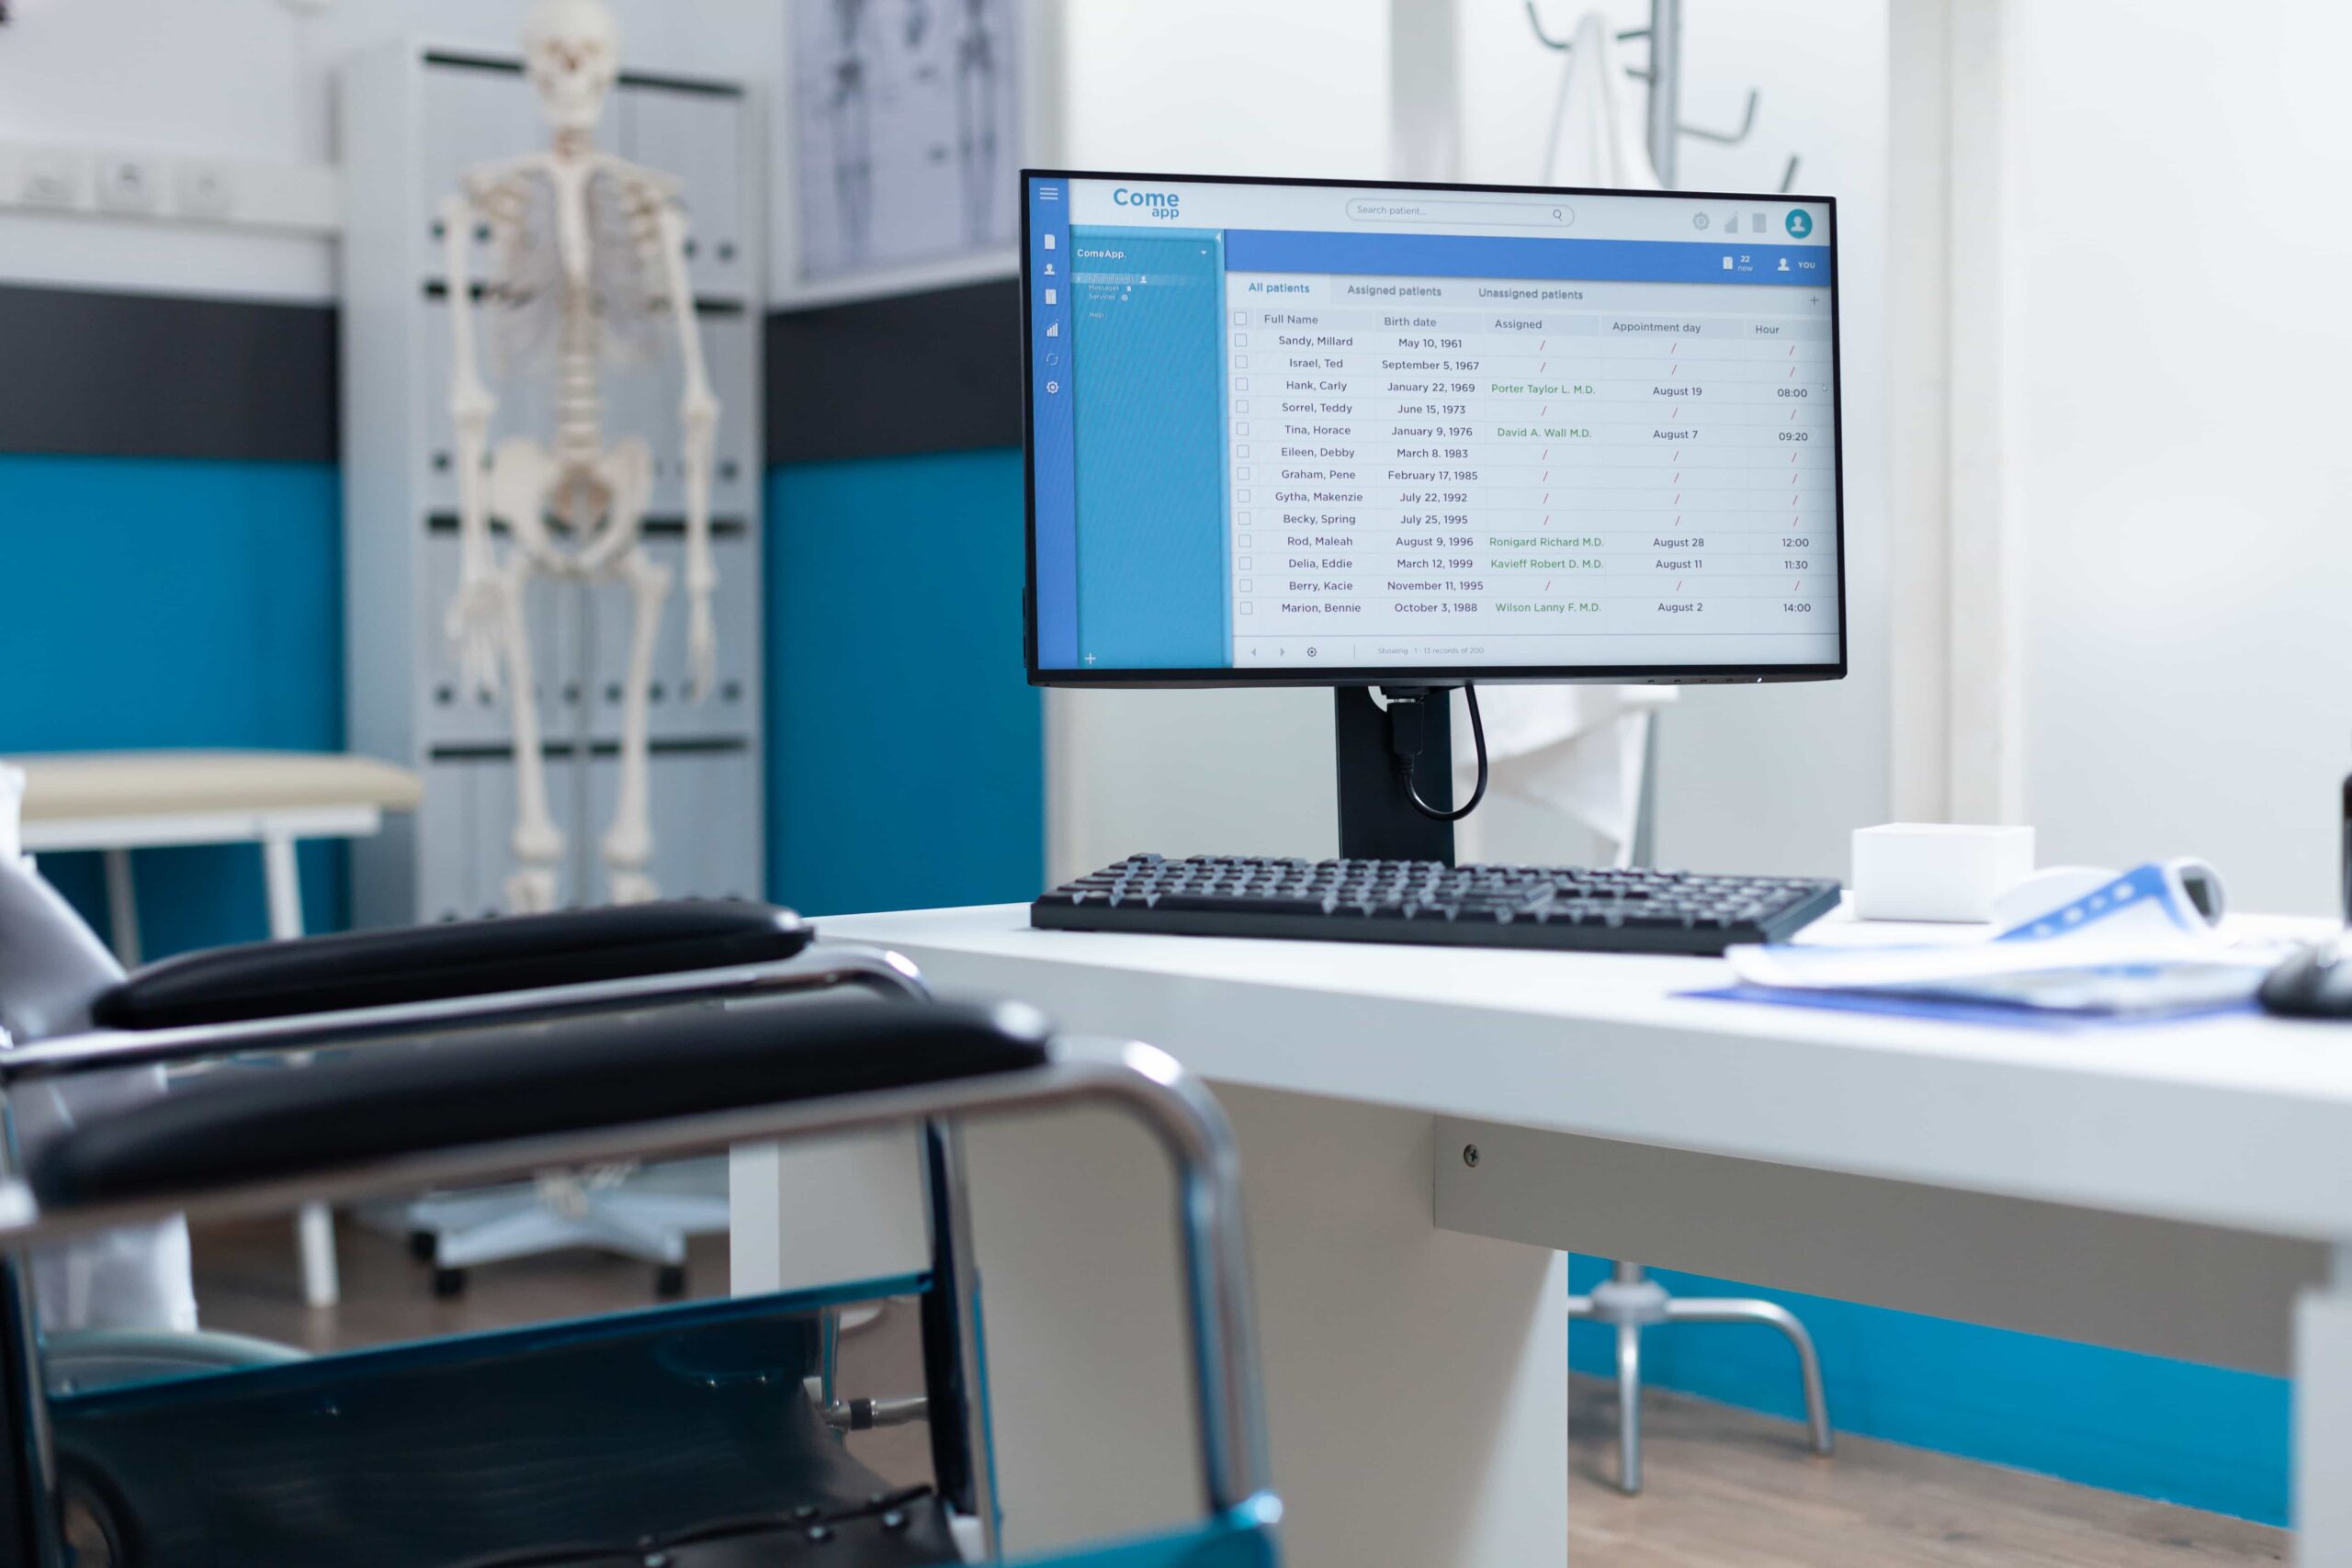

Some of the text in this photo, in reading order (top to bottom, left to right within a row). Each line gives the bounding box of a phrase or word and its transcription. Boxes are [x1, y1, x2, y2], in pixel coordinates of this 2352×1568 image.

[1114, 188, 1180, 208] Come
[1152, 208, 1180, 220] app
[1357, 205, 1386, 215] Search
[1798, 261, 1816, 270] YOU
[1249, 282, 1310, 294] All patients
[1347, 285, 1442, 297] Assigned patients
[1478, 288, 1583, 300] Unassigned patients
[1264, 314, 1318, 324] Full Name
[1385, 317, 1437, 327] Birth date
[1495, 319, 1543, 331] Assigned
[1612, 321, 1701, 334] Appointment day
[1756, 325, 1780, 334] Hour
[1279, 335, 1353, 347] Sandy, Millard
[1398, 338, 1462, 349] May 10, 1961
[1289, 358, 1343, 368] Israel, Ted
[1382, 360, 1479, 371] September 5, 1967
[1286, 380, 1347, 392] Hank, Carly
[1387, 382, 1476, 393] January 22, 1969
[1491, 384, 1595, 395] Porter Taylor L. M.D.
[1653, 387, 1702, 397] August 19
[1777, 389, 1808, 398] 08:00
[1282, 402, 1352, 414] Sorrel, Teddy
[1397, 404, 1465, 415] June 15, 1973
[1284, 424, 1351, 435] Tina, Horace
[1391, 426, 1473, 437] January 9, 1976
[1498, 427, 1591, 438] David A. Wall M.D.
[1653, 430, 1698, 440] August 7
[1779, 432, 1808, 442] 09:20
[1281, 447, 1355, 459] Eileen, Debby
[1396, 448, 1429, 457] March
[1444, 449, 1468, 458] 1983
[1281, 469, 1356, 480] Graham, Pene
[1388, 470, 1478, 481] February 17, 1985
[1275, 491, 1363, 502] Gytha, Makenzie
[1400, 492, 1467, 503] July 22, 1992
[1283, 514, 1356, 525] Becky, Spring
[1400, 514, 1468, 525] July 25, 1995
[1287, 536, 1352, 547] Rod, Maleah
[1396, 536, 1474, 547] August 9, 1996
[1489, 537, 1604, 548] Ronigard Richard M.D.
[1653, 537, 1704, 548] August 28
[1782, 538, 1810, 547] 12:00
[1288, 558, 1352, 570] Delia, Eddie
[1397, 559, 1473, 570] March 12, 1999
[1491, 558, 1603, 569] Kavieff Robert D. M.D.
[1656, 559, 1702, 570] August 11
[1784, 560, 1808, 570] 11:30
[1289, 581, 1353, 592] Berry, Kacie
[1387, 581, 1484, 592] November 11, 1995
[1282, 604, 1361, 614] Marion, Bennie
[1394, 603, 1477, 613] October 3, 1988
[1495, 603, 1531, 612] Wilson
[1534, 604, 1565, 614] Lanny
[1579, 603, 1601, 612] M.D.
[1657, 603, 1703, 614] August 2
[1783, 603, 1812, 613] 14:00
[1377, 647, 1408, 655] Showing
